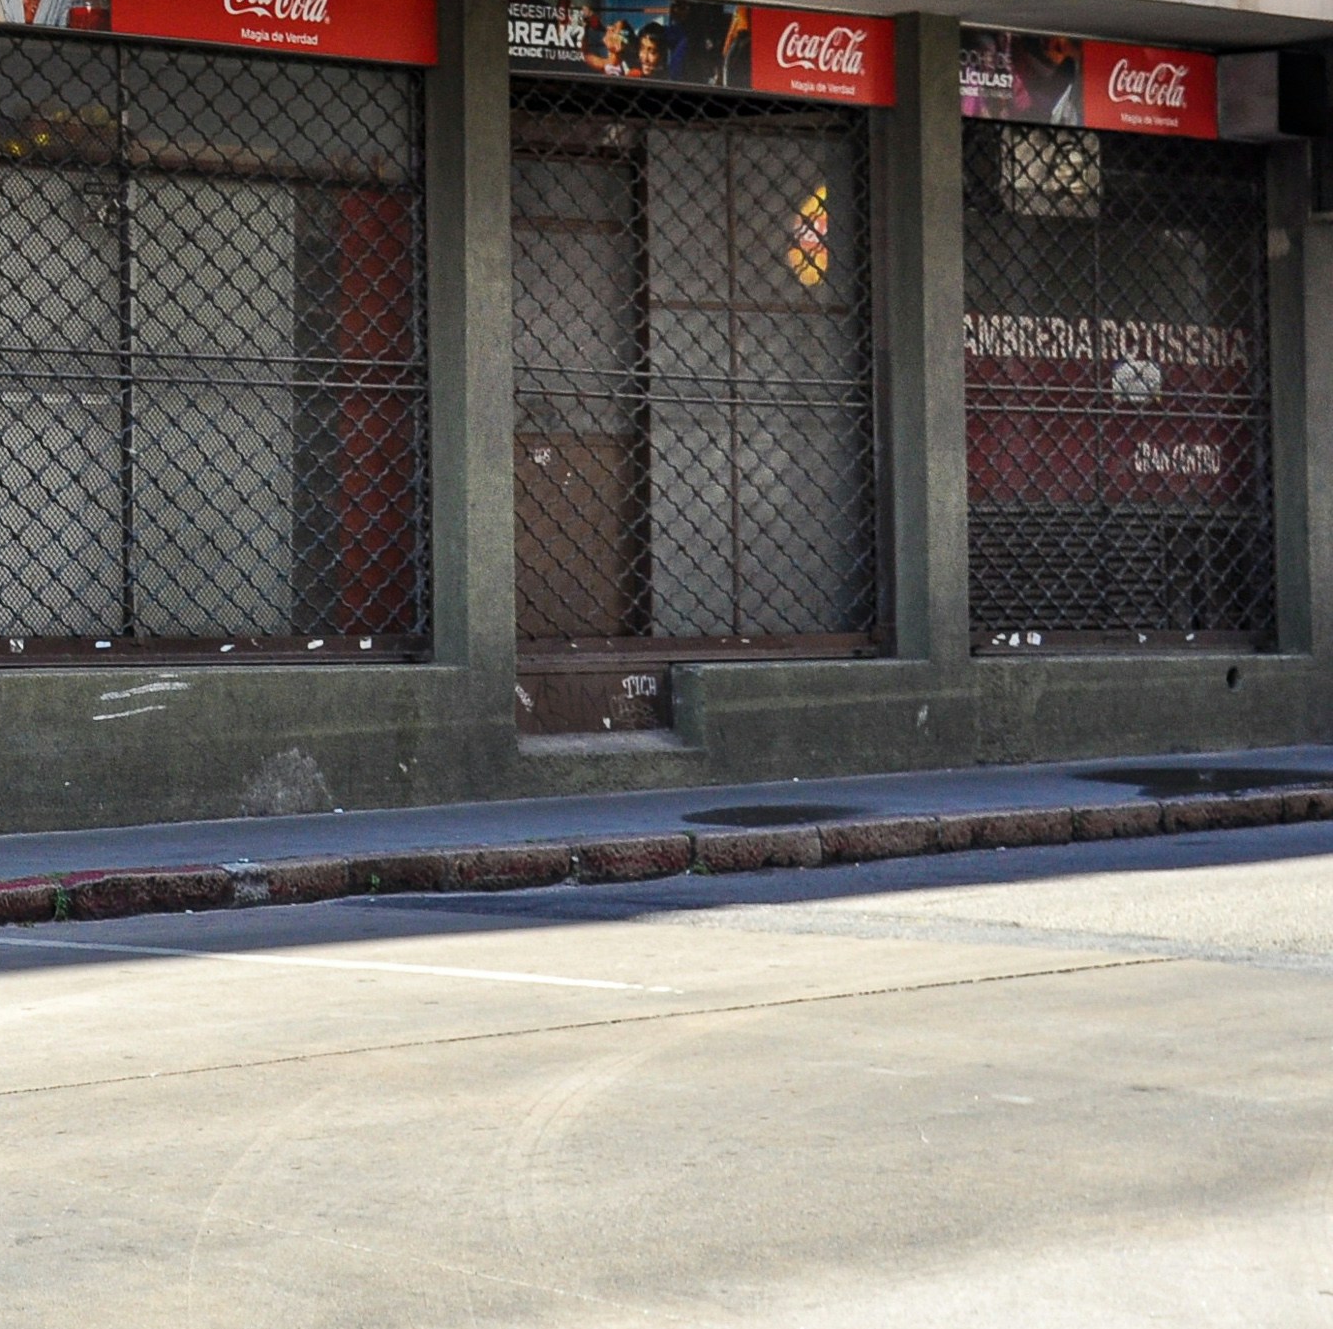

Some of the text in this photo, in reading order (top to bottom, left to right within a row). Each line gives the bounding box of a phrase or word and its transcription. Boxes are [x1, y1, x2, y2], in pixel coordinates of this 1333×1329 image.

[241, 28, 318, 45] Magia de Verdad
[777, 22, 867, 75] Coca-Cola
[959, 66, 1014, 88] LÍCULAS?
[1108, 58, 1188, 108] Coca-Cola
[963, 314, 1093, 359] AMBRERIA
